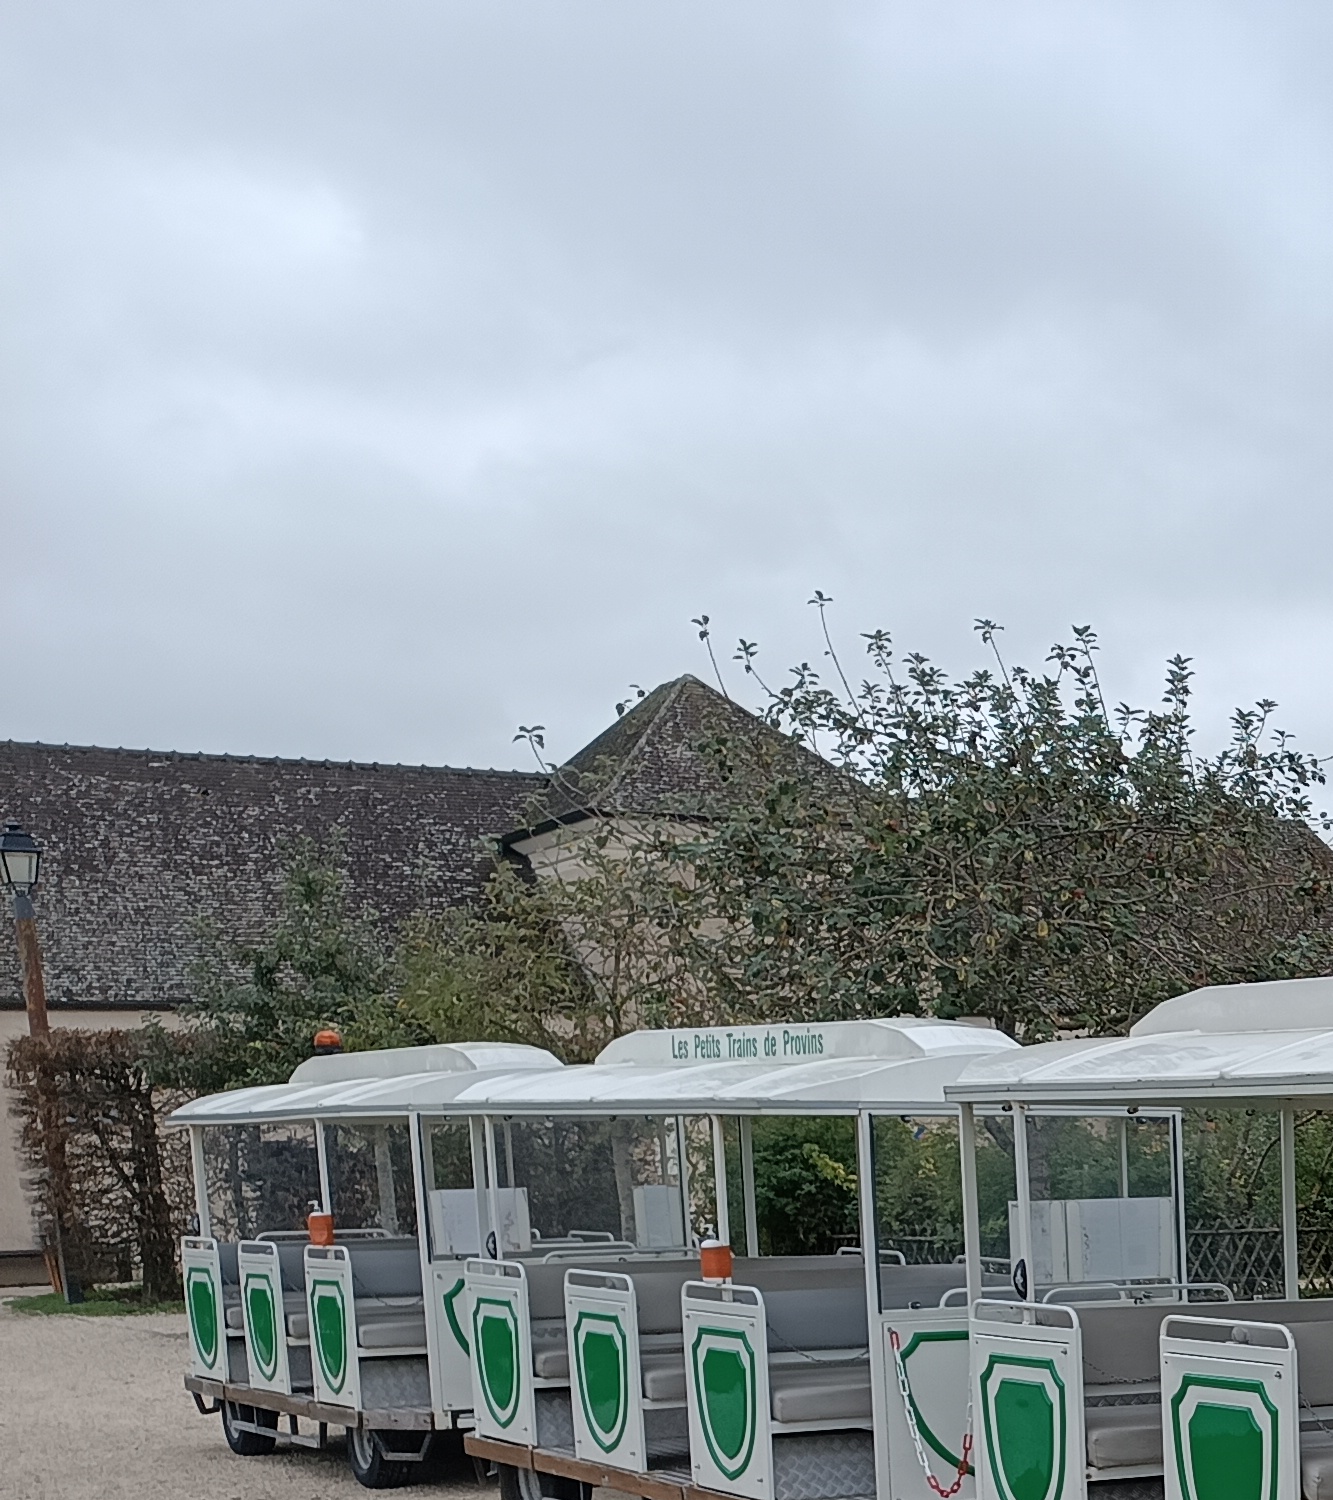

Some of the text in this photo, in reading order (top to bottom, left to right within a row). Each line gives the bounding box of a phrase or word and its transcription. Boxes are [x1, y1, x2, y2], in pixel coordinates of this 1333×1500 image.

[671, 1028, 824, 1059] Les Petits Trains de Provins
